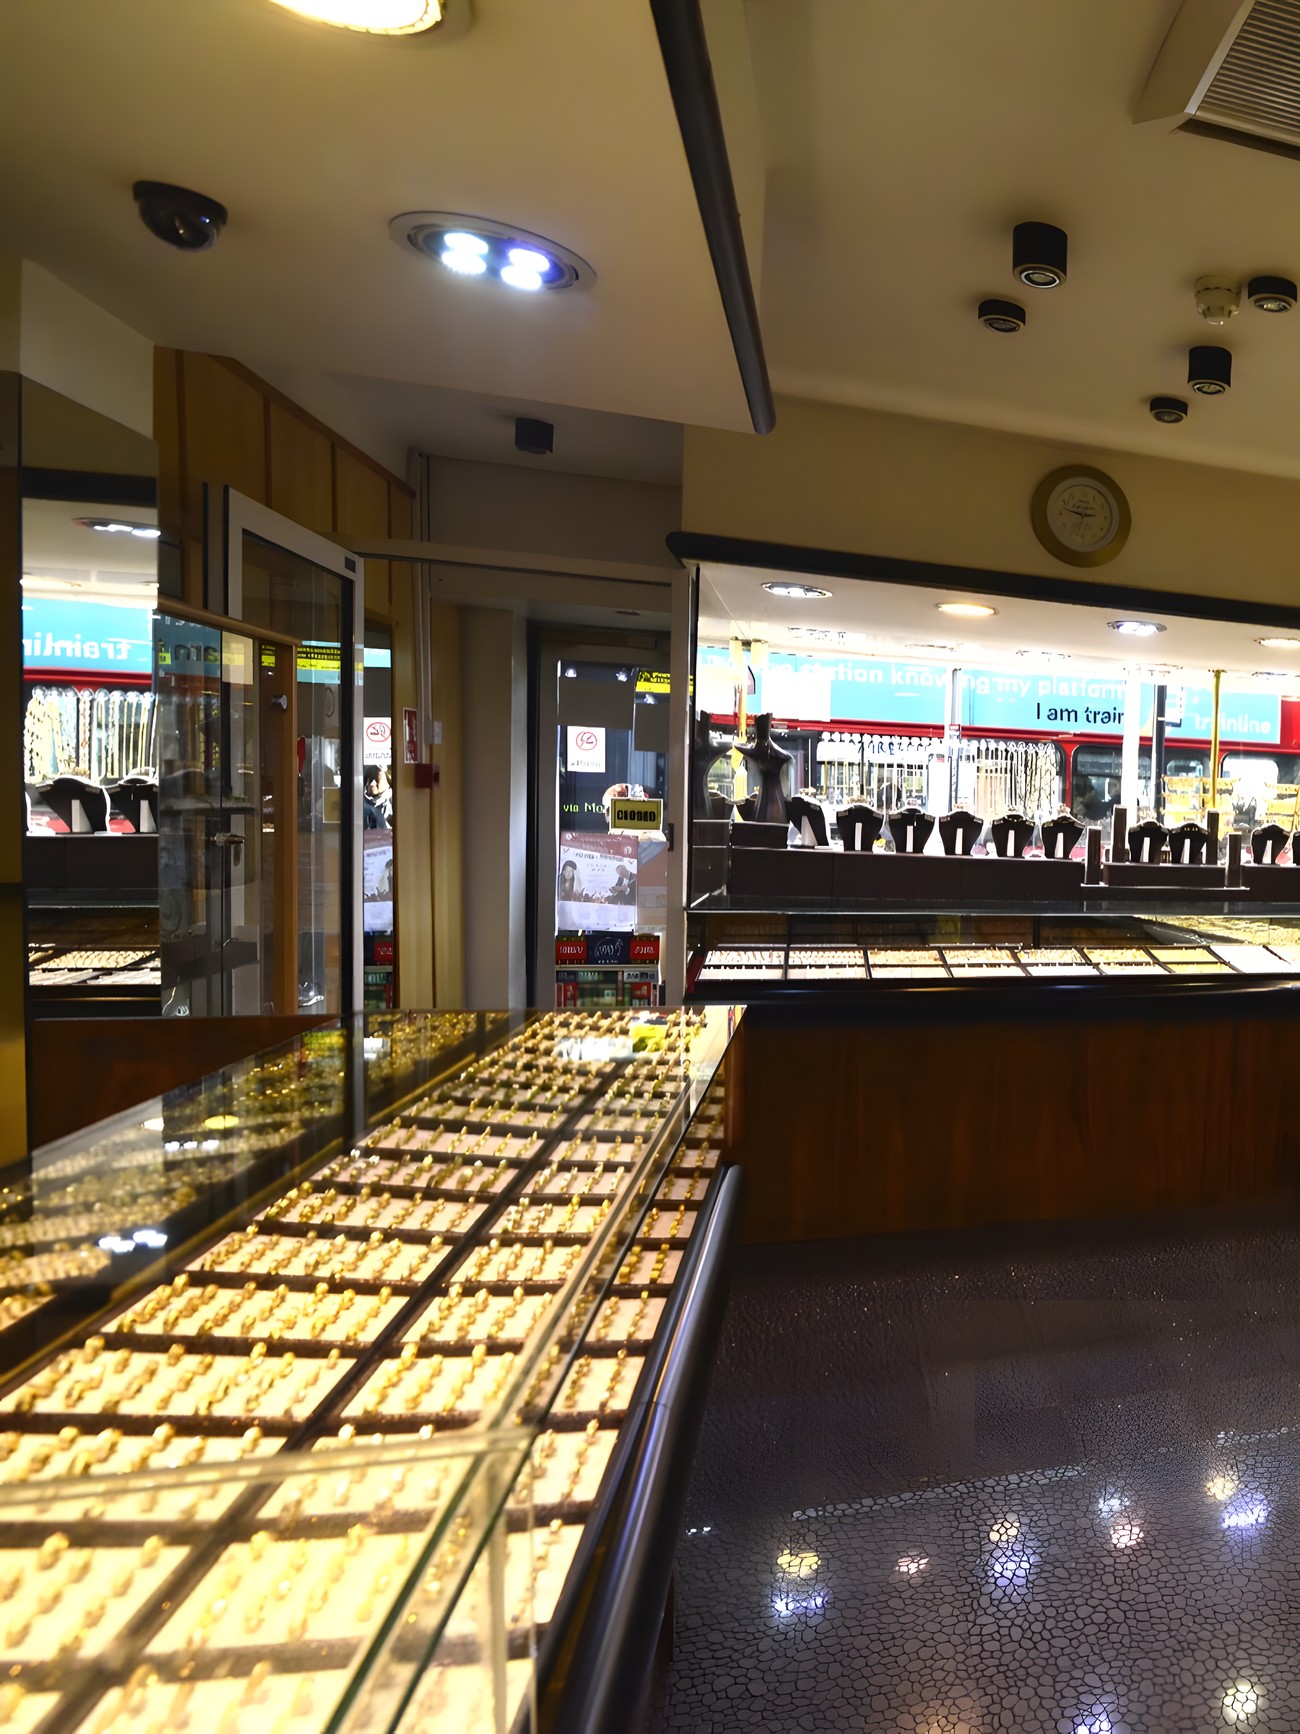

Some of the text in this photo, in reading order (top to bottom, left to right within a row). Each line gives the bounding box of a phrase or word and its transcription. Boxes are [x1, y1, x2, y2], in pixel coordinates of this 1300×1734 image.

[802, 661, 883, 684] sttion
[891, 663, 990, 694] knowng
[1047, 706, 1078, 723] am
[1194, 712, 1271, 735] trinline
[563, 801, 604, 814] via Mo
